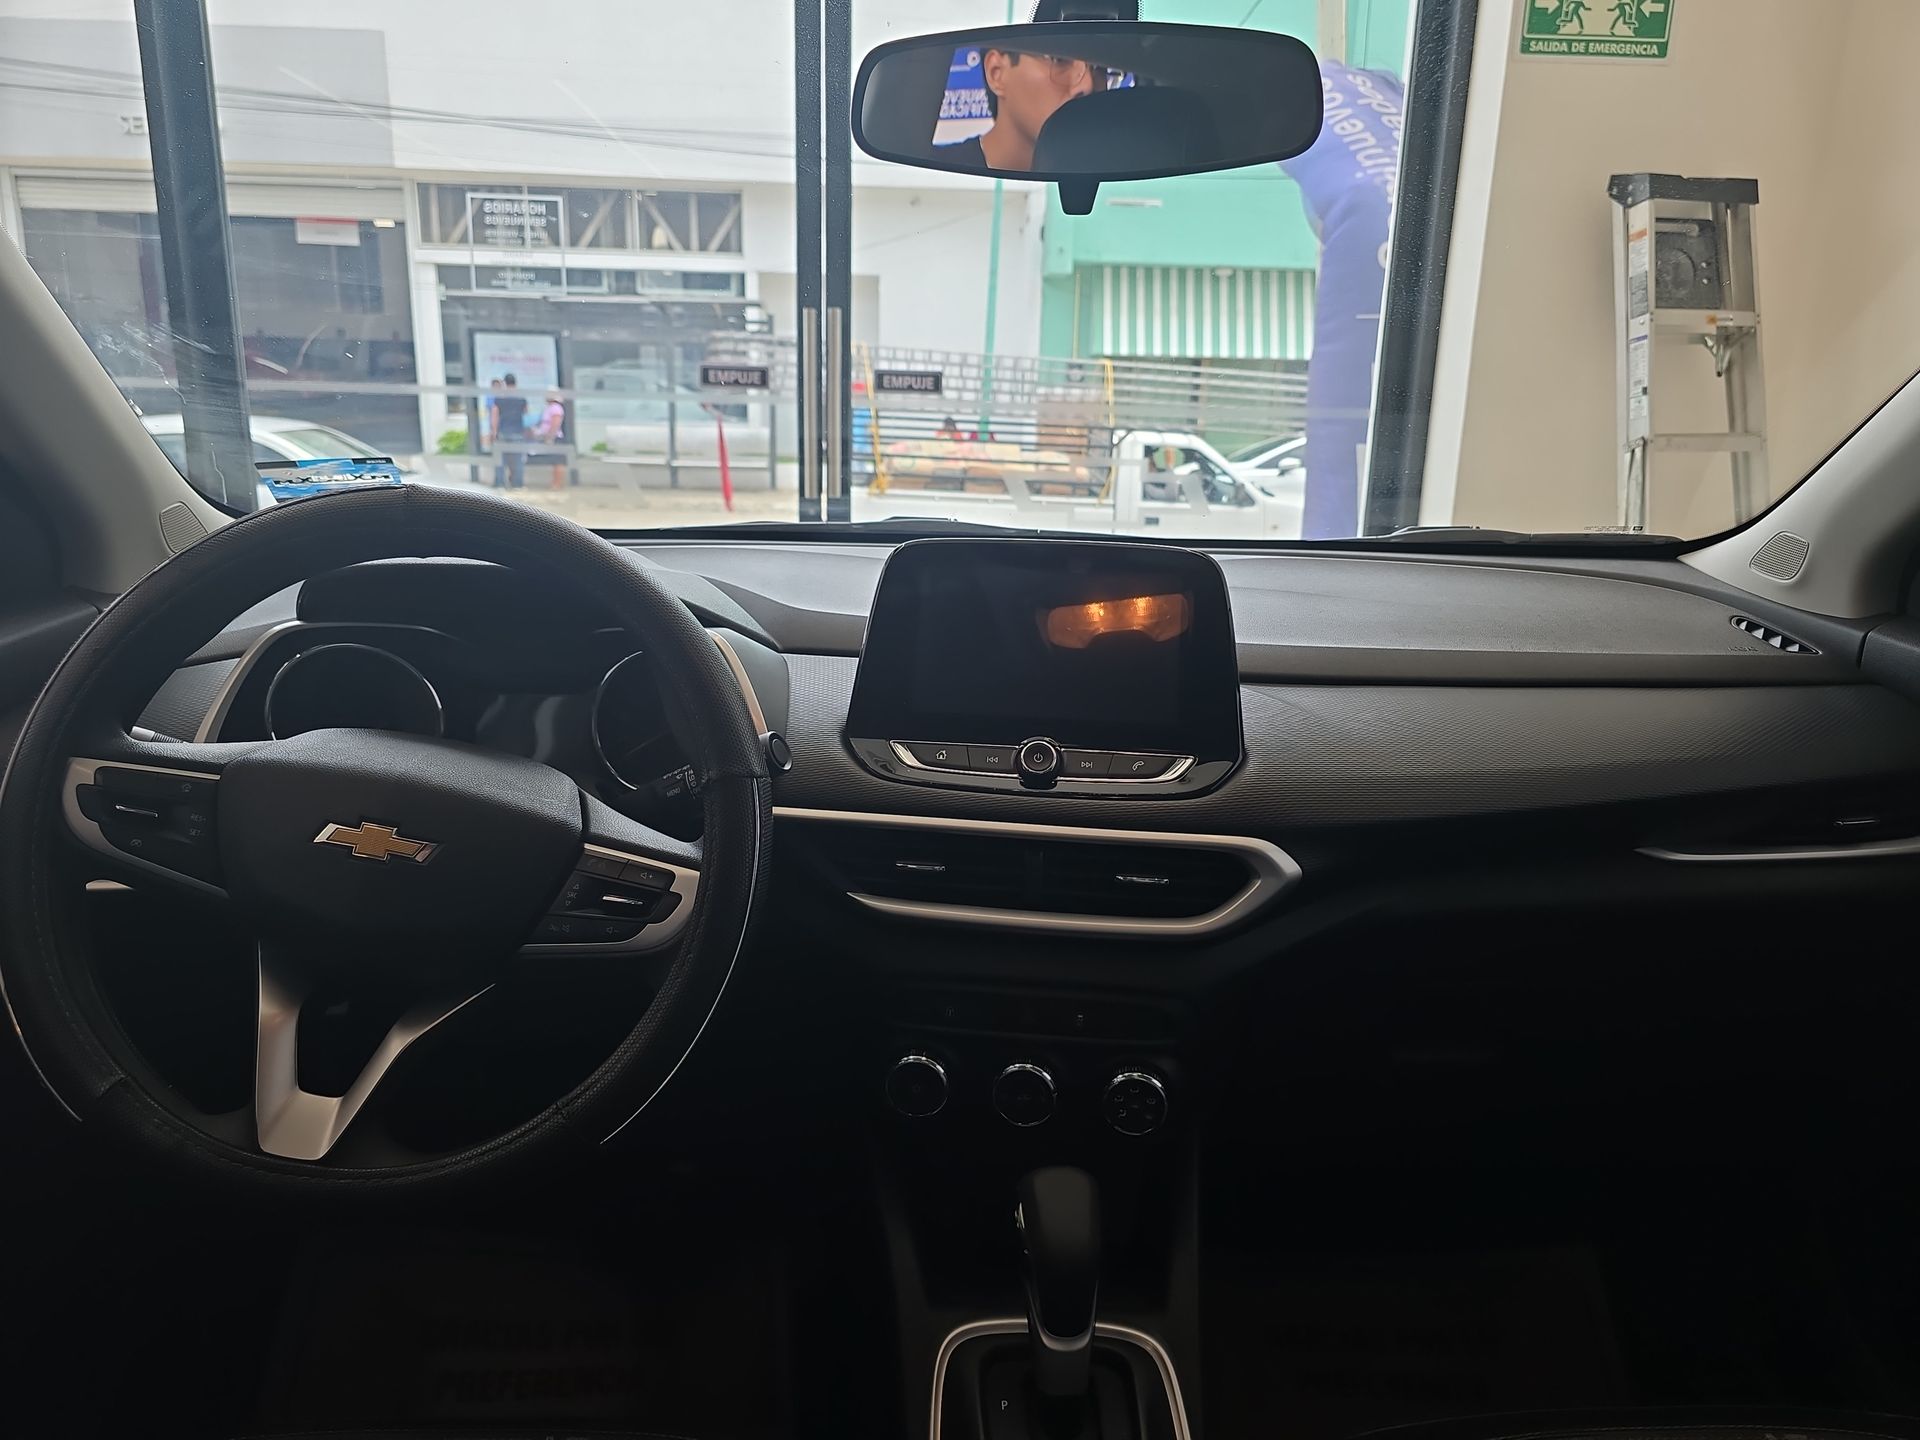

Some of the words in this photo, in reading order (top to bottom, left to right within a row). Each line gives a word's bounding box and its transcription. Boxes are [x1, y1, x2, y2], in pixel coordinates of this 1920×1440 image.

[1529, 41, 1569, 53] SALIDA
[1571, 42, 1585, 53] DE
[1588, 43, 1659, 55] EMERGENCIA
[707, 369, 763, 386] EMPUJE
[883, 375, 936, 390] EMPUJE
[1001, 1399, 1009, 1410] P
